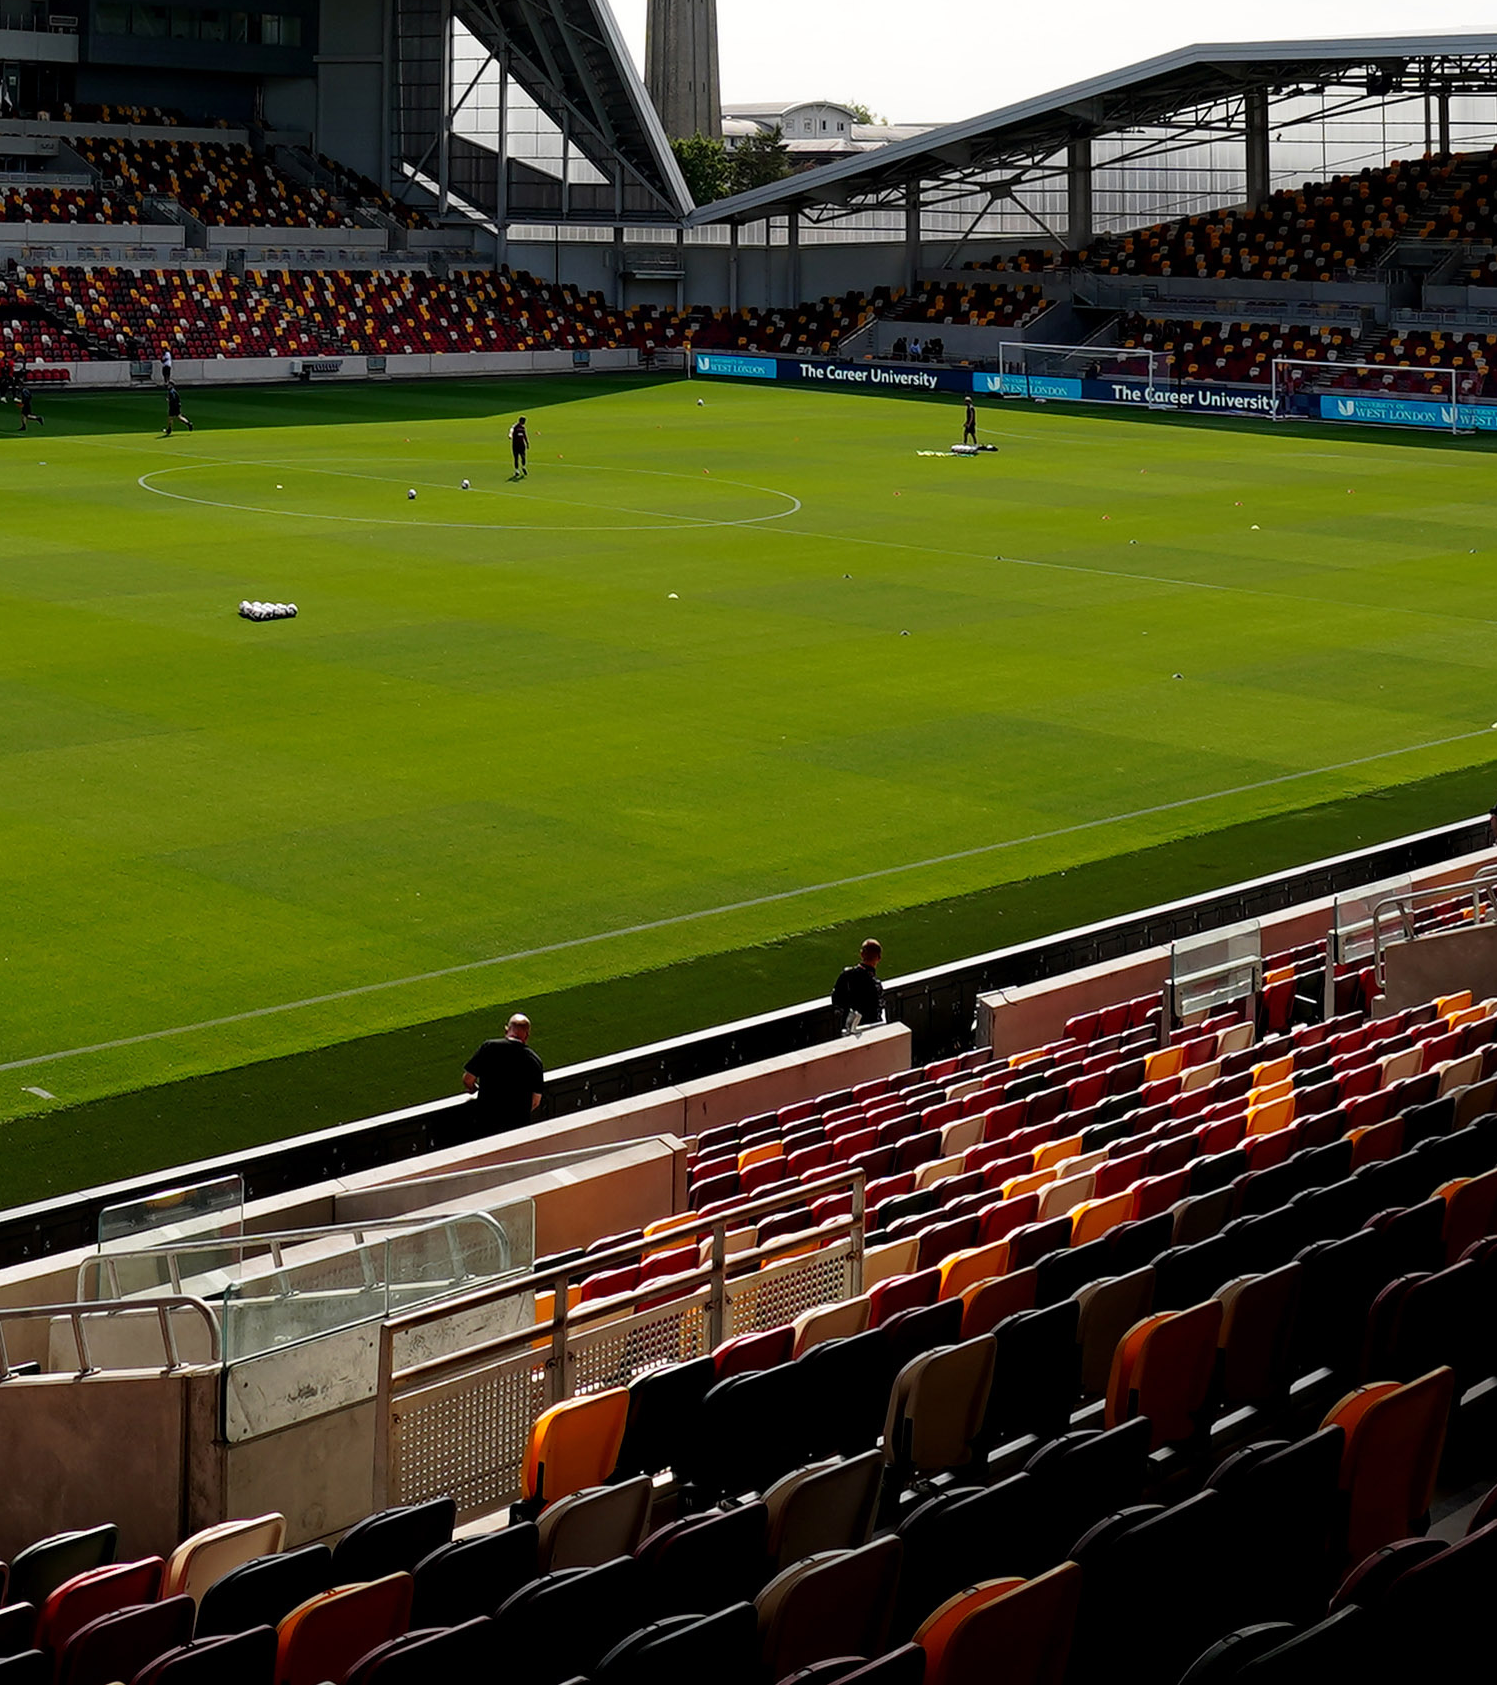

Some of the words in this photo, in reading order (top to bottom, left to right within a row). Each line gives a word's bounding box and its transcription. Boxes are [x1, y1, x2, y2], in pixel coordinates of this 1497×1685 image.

[710, 363, 732, 373] WEST
[733, 364, 766, 375] LONDON
[799, 363, 825, 379] The
[826, 365, 868, 382] Career
[870, 368, 938, 390] University
[1001, 383, 1027, 394] WEST
[1029, 384, 1068, 396] LONDON
[1111, 384, 1142, 402] The
[1145, 386, 1195, 405] Career
[1197, 390, 1280, 414] University
[1355, 407, 1387, 419] WEST
[1389, 409, 1437, 422] LONDON
[1459, 414, 1494, 426] WEST
